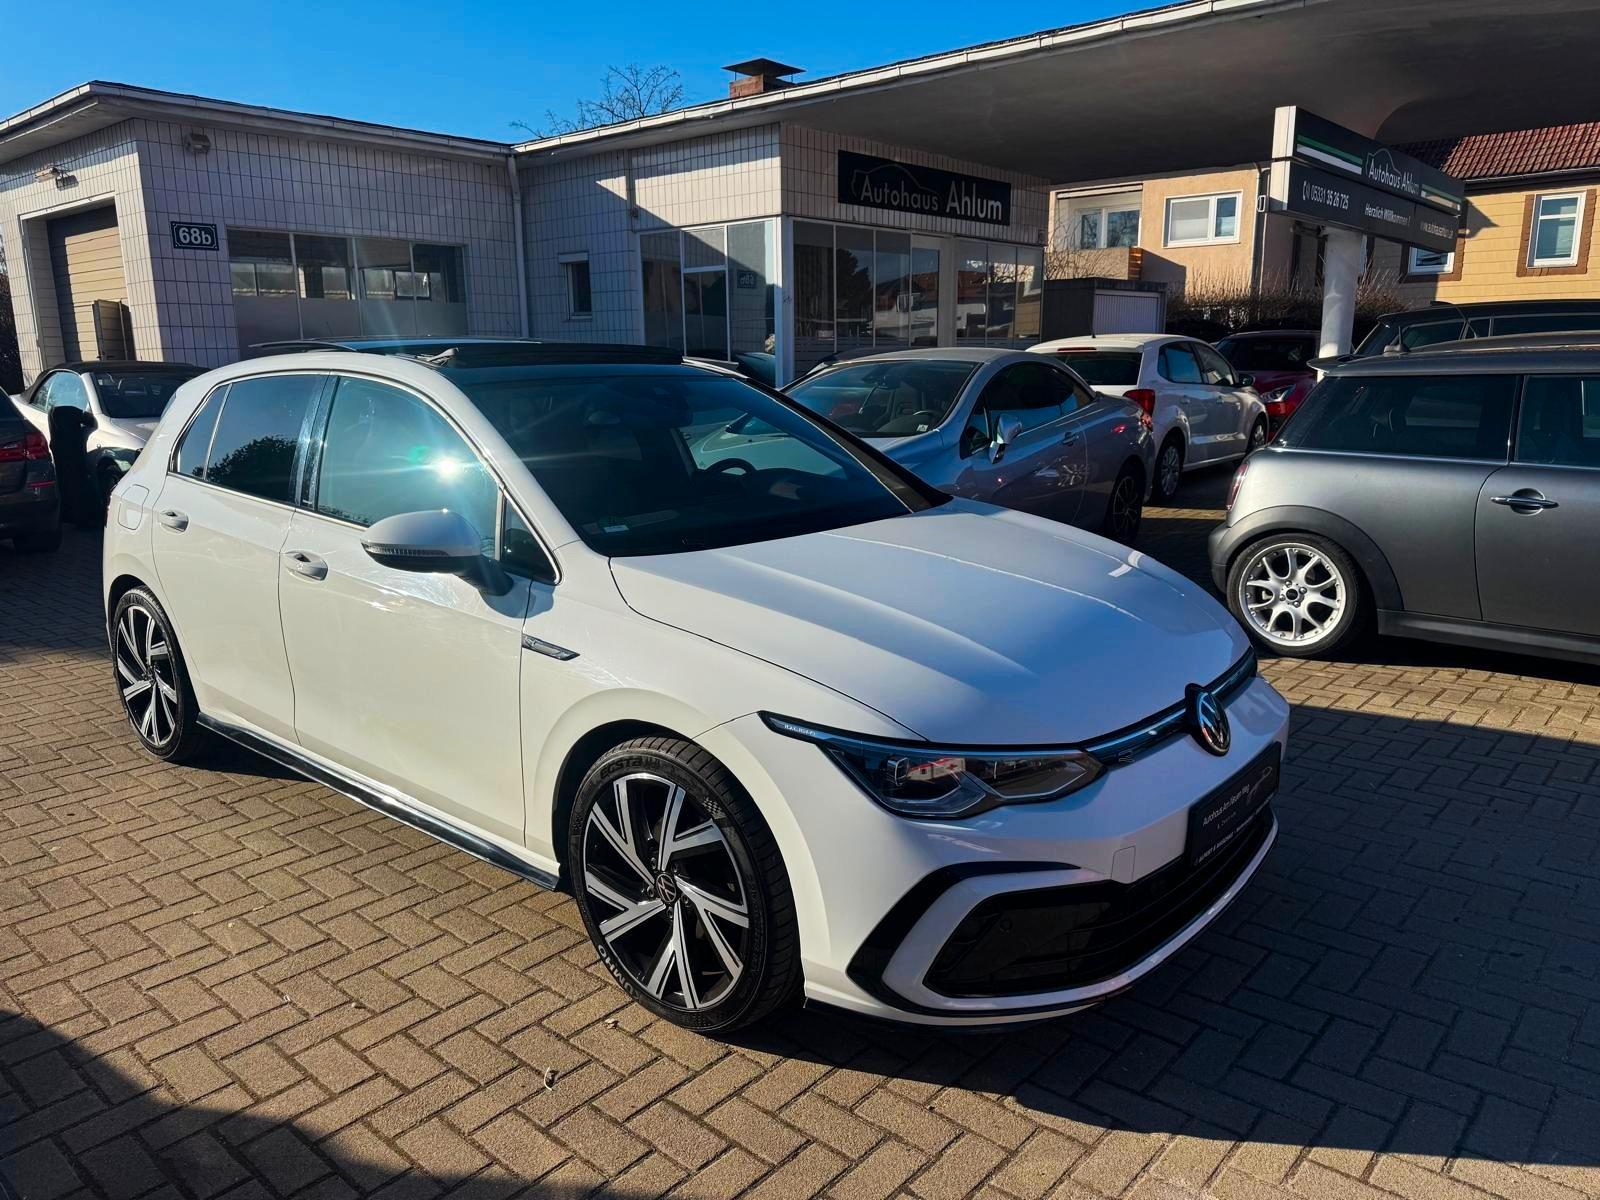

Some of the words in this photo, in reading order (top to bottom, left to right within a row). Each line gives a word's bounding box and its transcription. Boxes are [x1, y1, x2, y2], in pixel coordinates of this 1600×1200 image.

[1368, 158, 1401, 189] Autohaus
[861, 175, 938, 211] Autohaus
[945, 180, 1002, 221] Ahlum
[1311, 184, 1326, 204] 05331
[1364, 202, 1384, 219] Herzlich
[179, 227, 212, 245] 68b
[597, 944, 640, 1001] KUMHO
